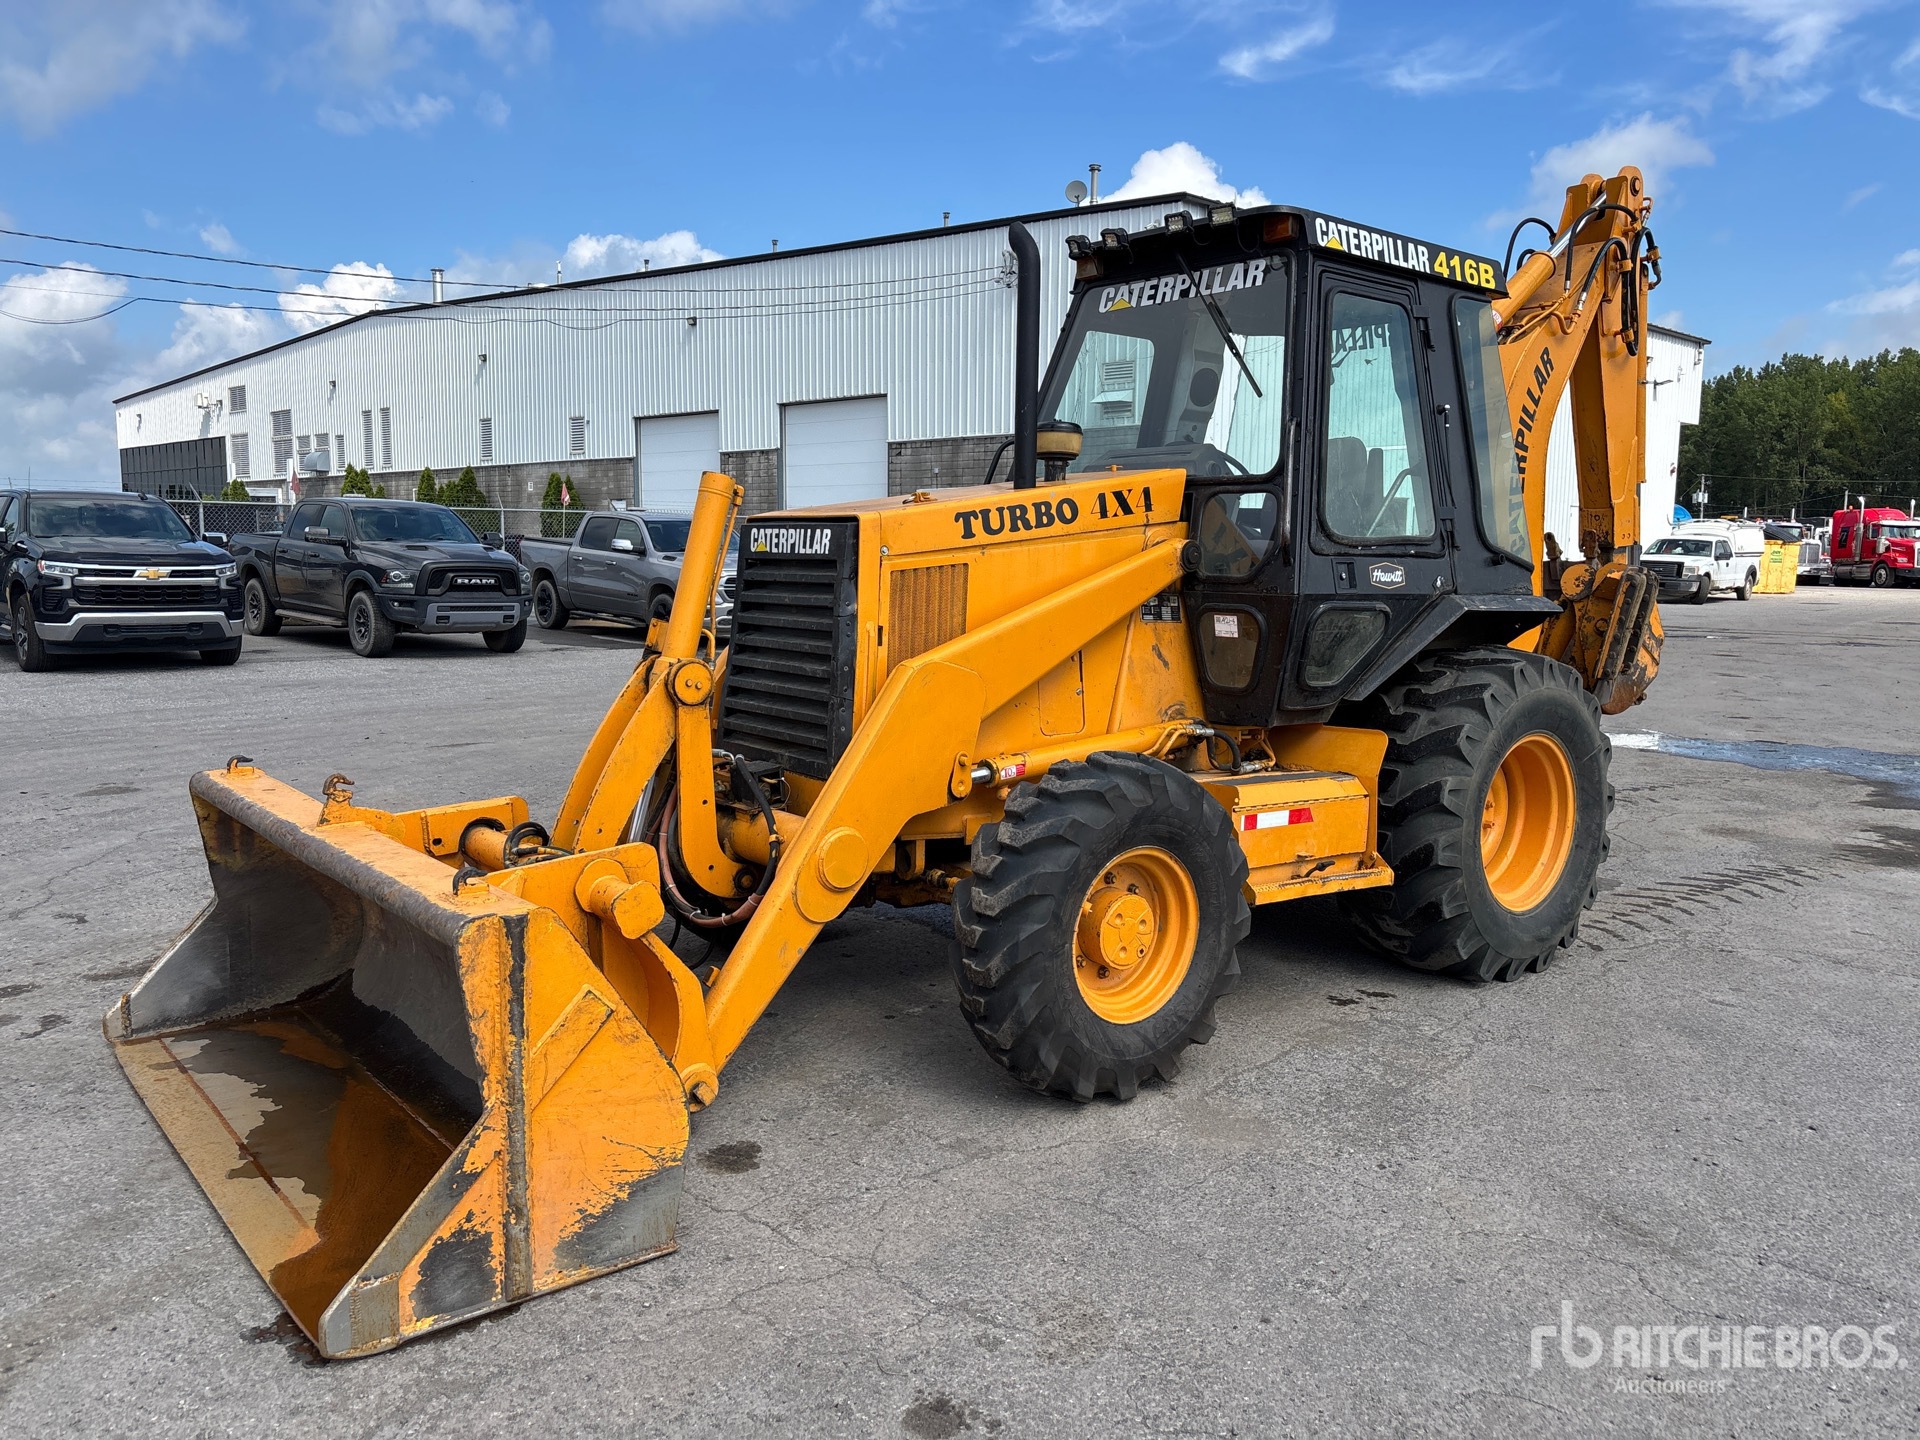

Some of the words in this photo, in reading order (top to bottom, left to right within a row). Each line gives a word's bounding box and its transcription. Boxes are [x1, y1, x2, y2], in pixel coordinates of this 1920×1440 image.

[1315, 217, 1431, 274] CATERPILLAR
[1433, 251, 1496, 289] 416B
[1098, 259, 1266, 313] CATERPILLAR
[954, 497, 1079, 540] TURBO
[1090, 486, 1154, 520] 4X4
[750, 527, 832, 554] CATERPILLAR
[1372, 568, 1403, 582] Hewitt
